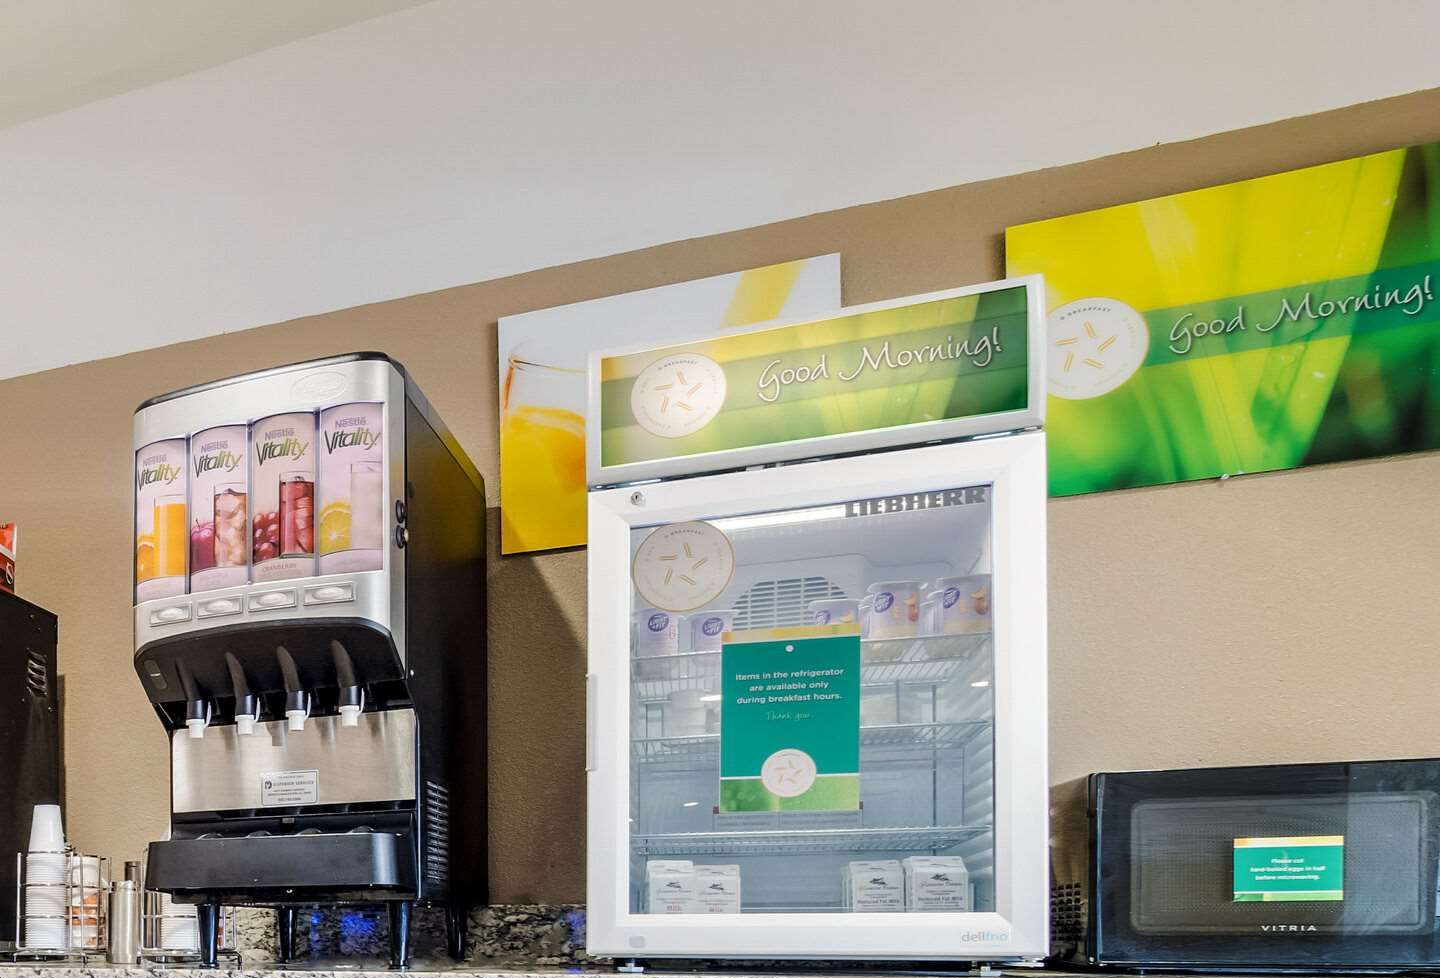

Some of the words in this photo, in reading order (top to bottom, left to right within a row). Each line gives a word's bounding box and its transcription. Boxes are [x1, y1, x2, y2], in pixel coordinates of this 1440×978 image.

[1168, 306, 1247, 354] Good
[1255, 275, 1433, 334] Morning!
[757, 354, 829, 402] Good
[839, 326, 1004, 382] Morning!
[256, 438, 309, 466] Vitality
[325, 427, 381, 455] Vitality
[138, 464, 181, 491] Vitality
[194, 451, 243, 478] Vitality
[845, 487, 985, 518] LIEBHERR
[736, 673, 760, 681] Items
[791, 668, 843, 678] refrigerator
[766, 681, 806, 691] available
[809, 681, 829, 690] only
[737, 696, 766, 704] during
[768, 694, 810, 703] breakfast
[813, 692, 842, 700] hours.
